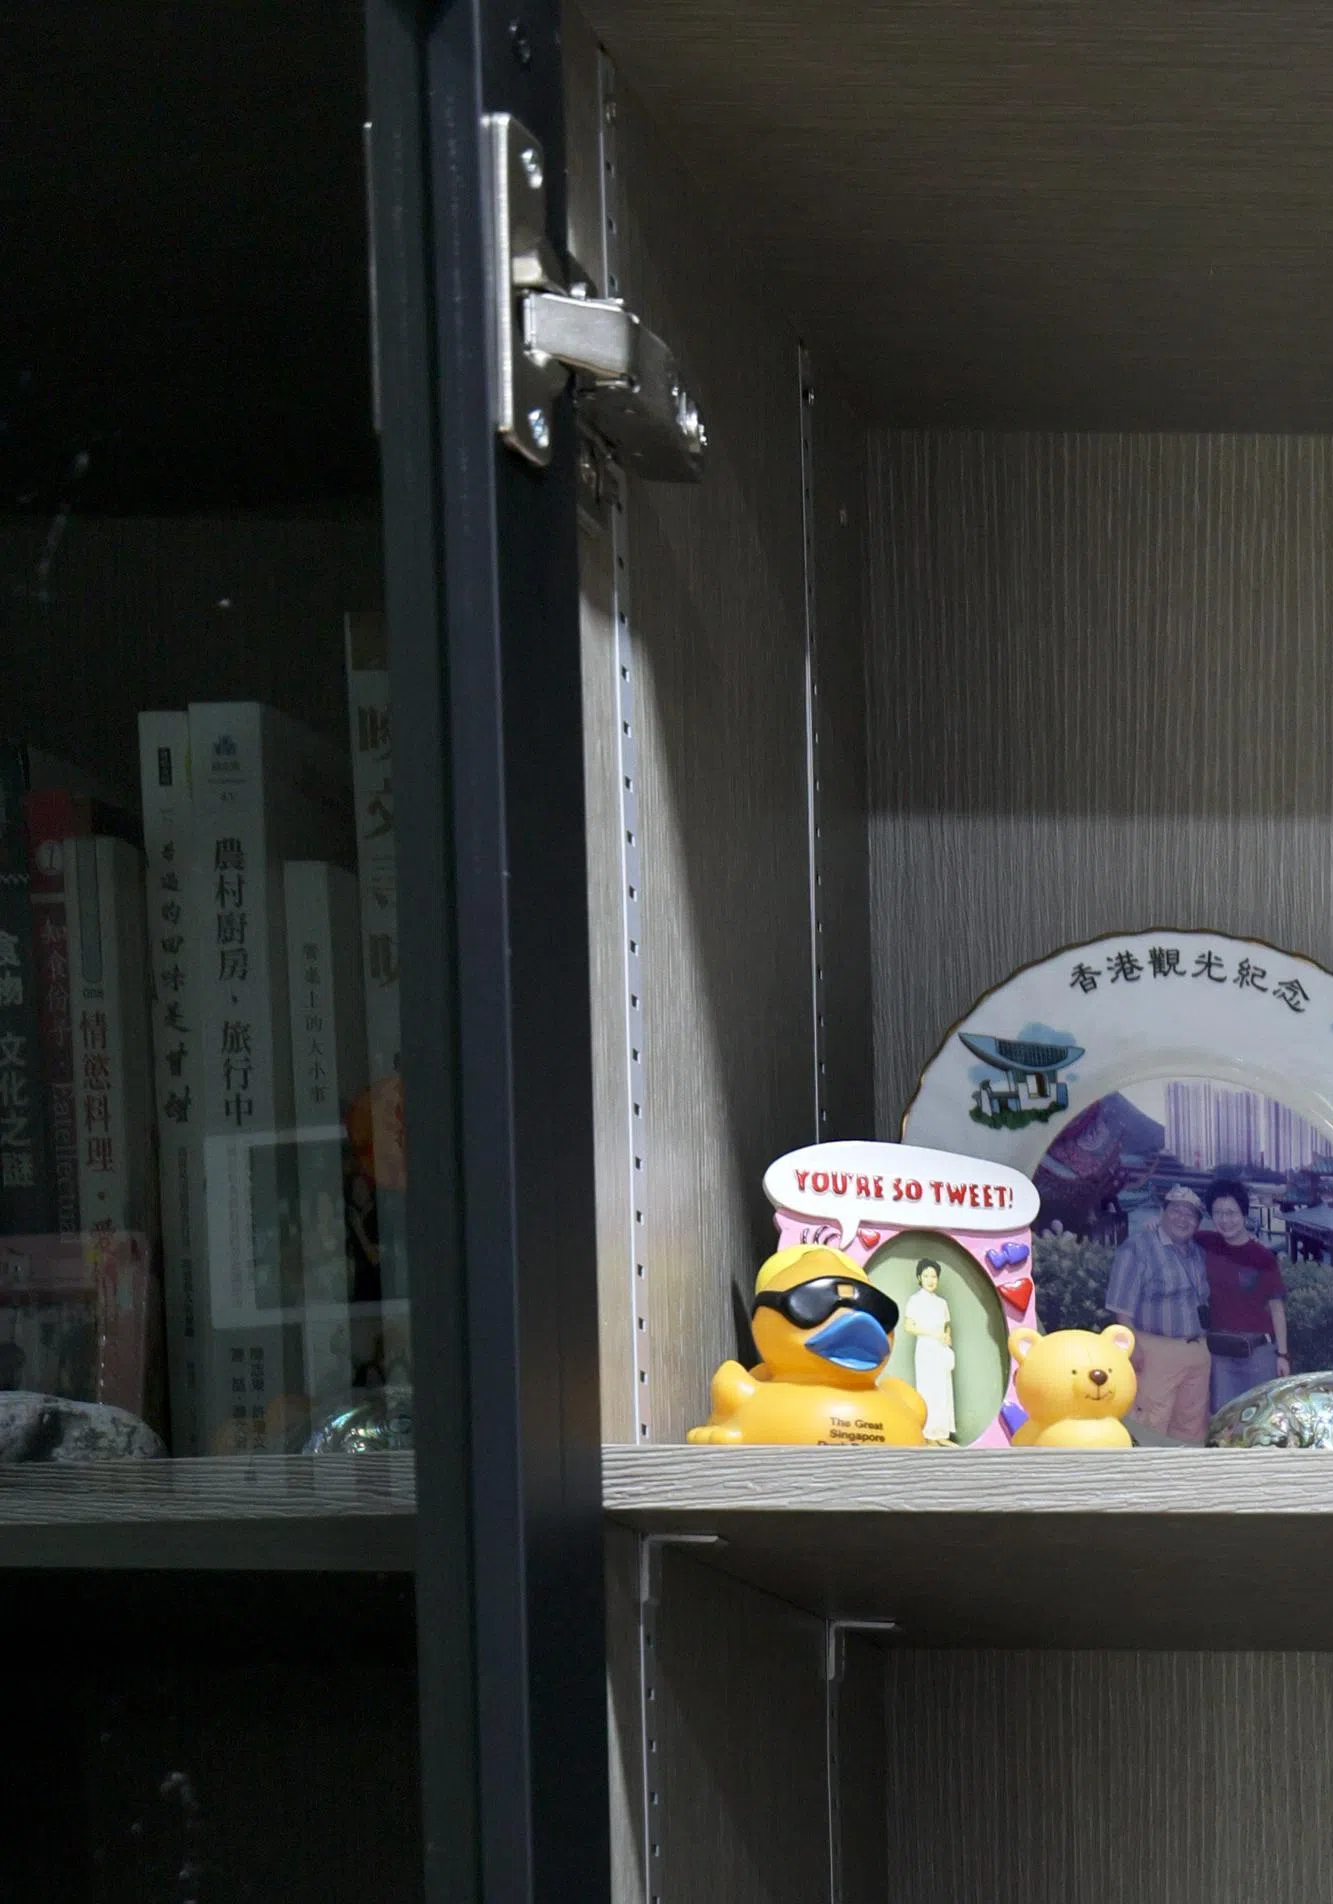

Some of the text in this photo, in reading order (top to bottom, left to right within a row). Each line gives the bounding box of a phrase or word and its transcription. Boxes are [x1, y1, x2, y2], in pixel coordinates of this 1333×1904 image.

[1070, 946, 1312, 1014] 香港觀光紀念
[795, 1169, 1013, 1209] YOU'RE SO TWEET!
[829, 1429, 885, 1442] Singapore
[830, 1417, 883, 1431] The Great
